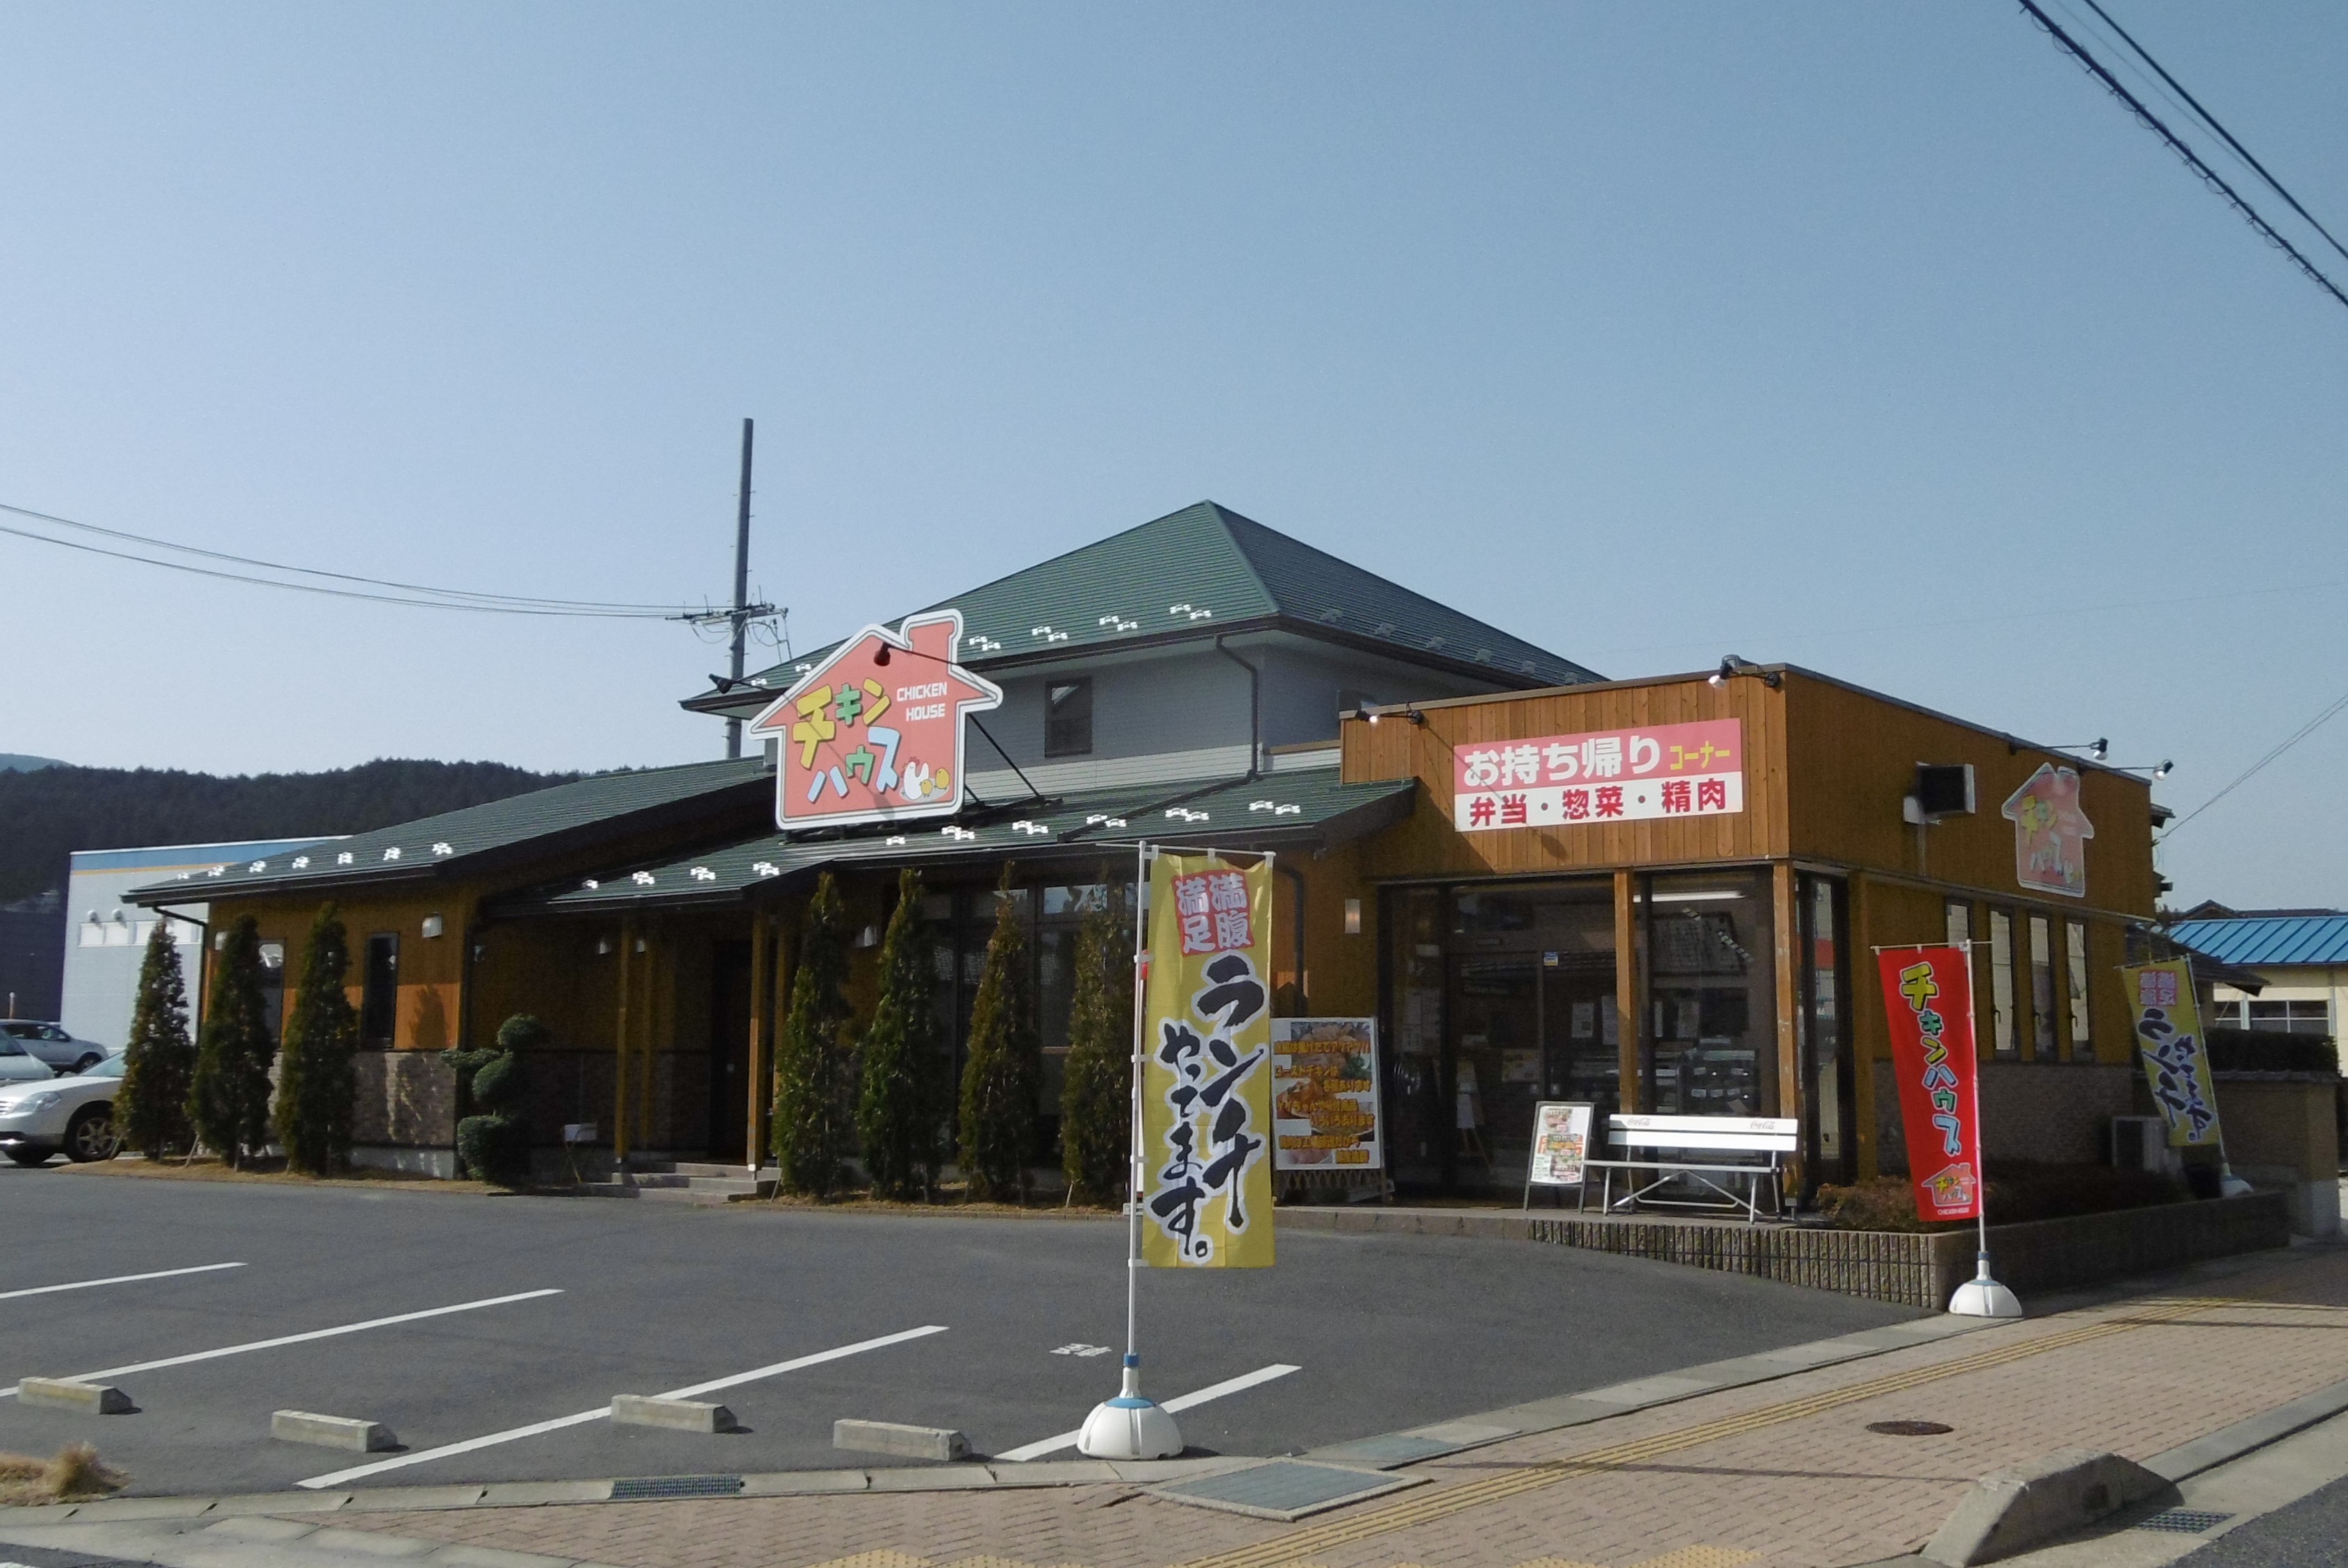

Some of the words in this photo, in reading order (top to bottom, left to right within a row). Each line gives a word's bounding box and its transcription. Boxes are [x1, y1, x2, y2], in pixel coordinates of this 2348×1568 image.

[793, 678, 891, 769] チキン
[896, 681, 948, 702] CHICKEN
[905, 703, 946, 722] HOUSE
[807, 725, 901, 802] ハウス
[1464, 735, 1661, 787] お持ち帰り
[1669, 740, 1730, 770] コーナー
[1175, 875, 1216, 952] 満足
[1208, 872, 1251, 948] 満腹
[1196, 954, 1266, 1228] ランチ
[1900, 962, 1961, 1156] チキンハウス
